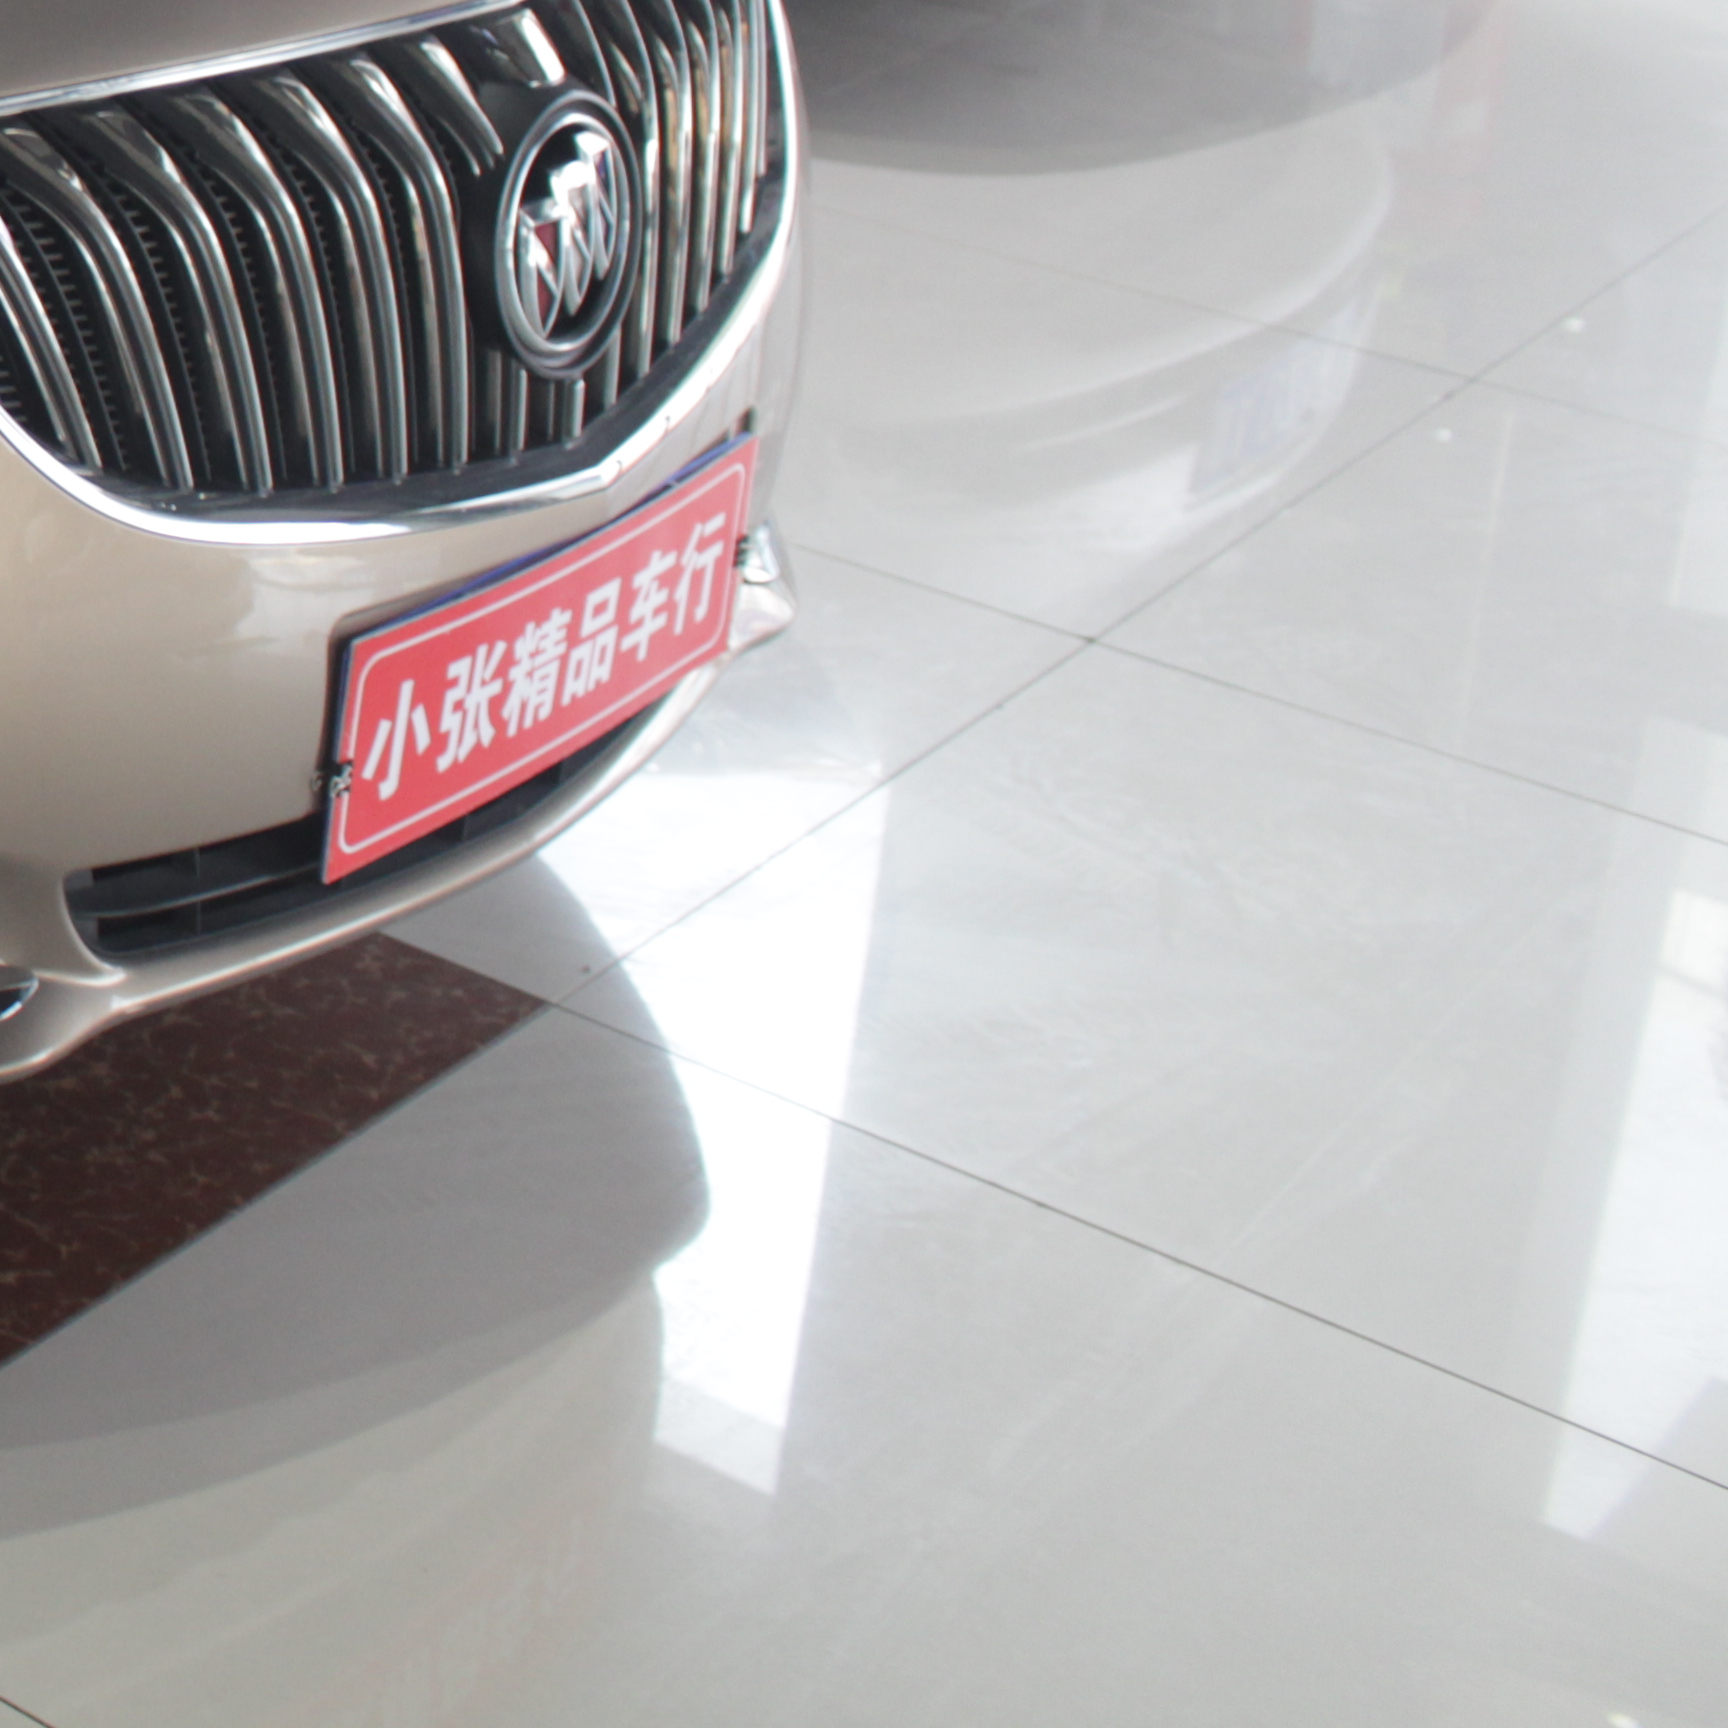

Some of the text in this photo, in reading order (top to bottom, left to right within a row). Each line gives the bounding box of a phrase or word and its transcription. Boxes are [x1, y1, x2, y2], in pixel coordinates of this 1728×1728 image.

[361, 512, 726, 801] 小张精品车行
